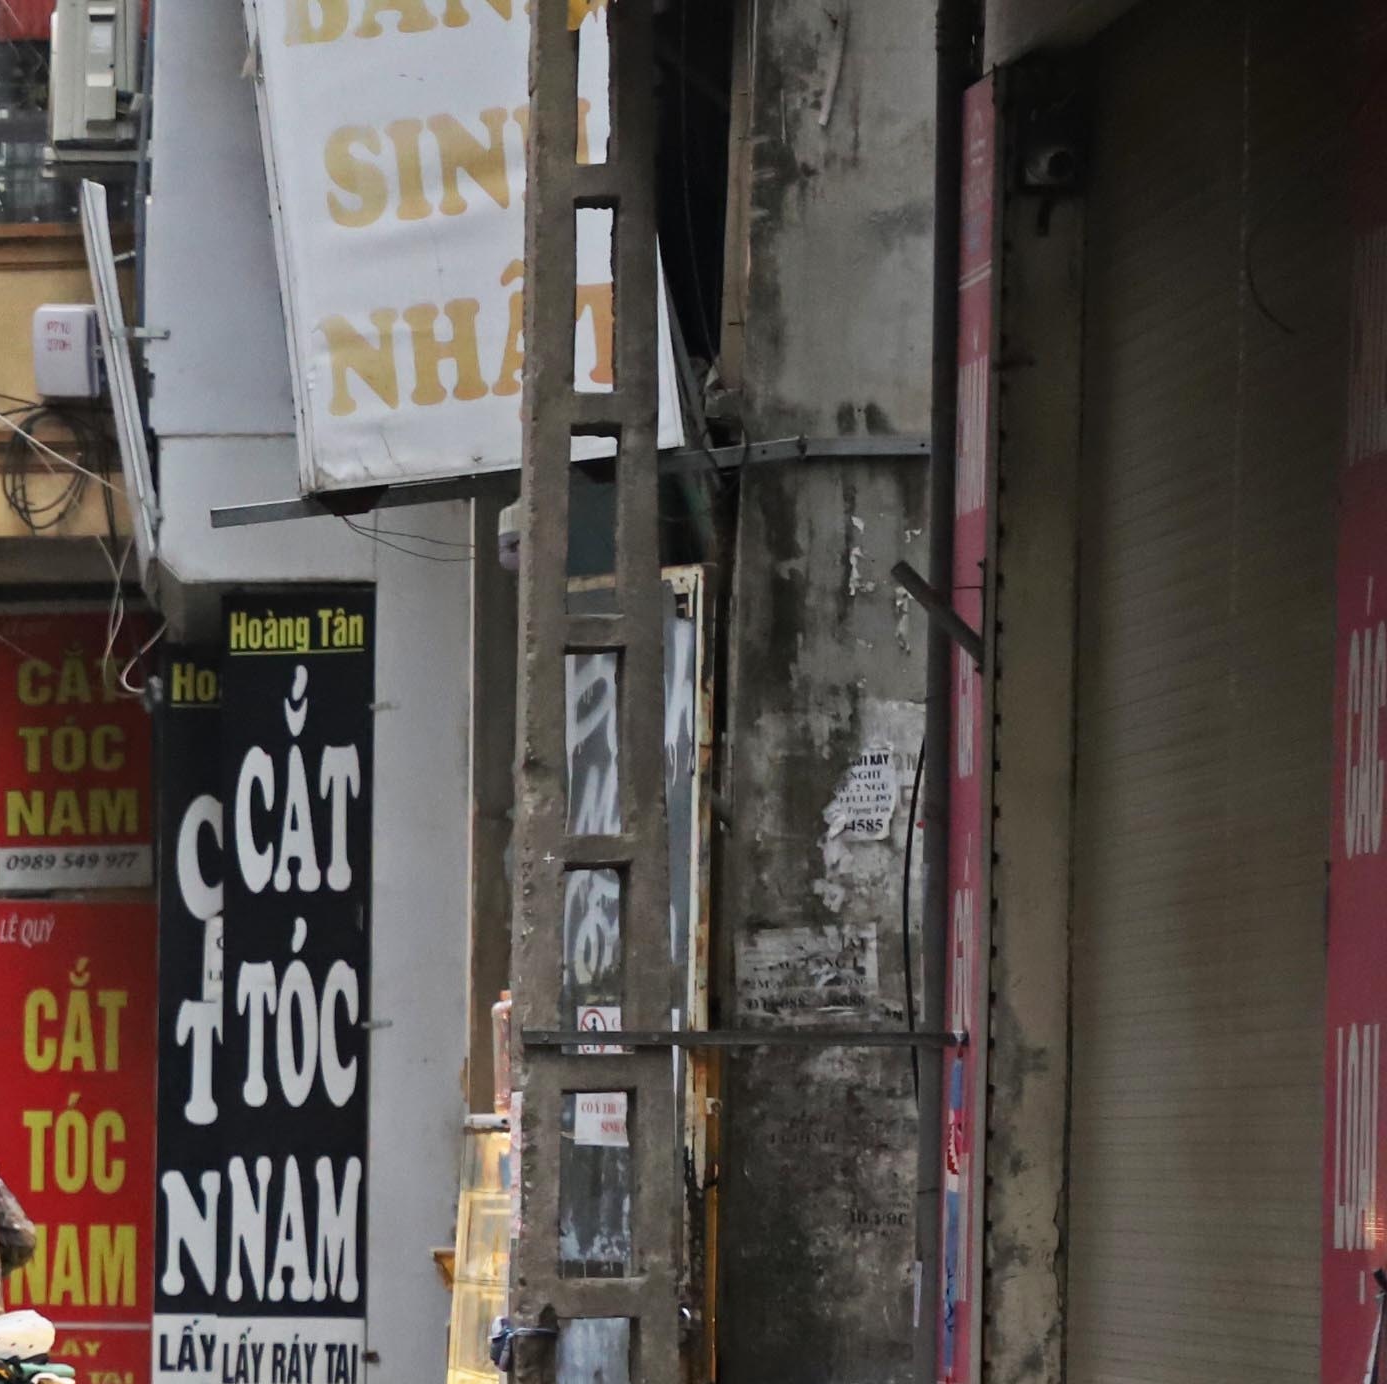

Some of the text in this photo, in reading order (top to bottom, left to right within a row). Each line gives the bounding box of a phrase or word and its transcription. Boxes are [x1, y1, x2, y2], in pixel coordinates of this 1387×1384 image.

[230, 609, 364, 652] Hoàng Tân
[19, 715, 125, 773] TÓC
[235, 665, 361, 893] CẮT
[6, 788, 138, 837] NAM
[6, 853, 139, 872] 0989 549 977
[0, 919, 18, 942] LÊ
[24, 957, 128, 1072] CẮT
[236, 916, 359, 1107] TÓC
[23, 1092, 126, 1193] TÓC
[228, 1155, 362, 1302] NAM
[10, 1224, 138, 1307] NAM
[160, 1319, 217, 1372] LẤY
